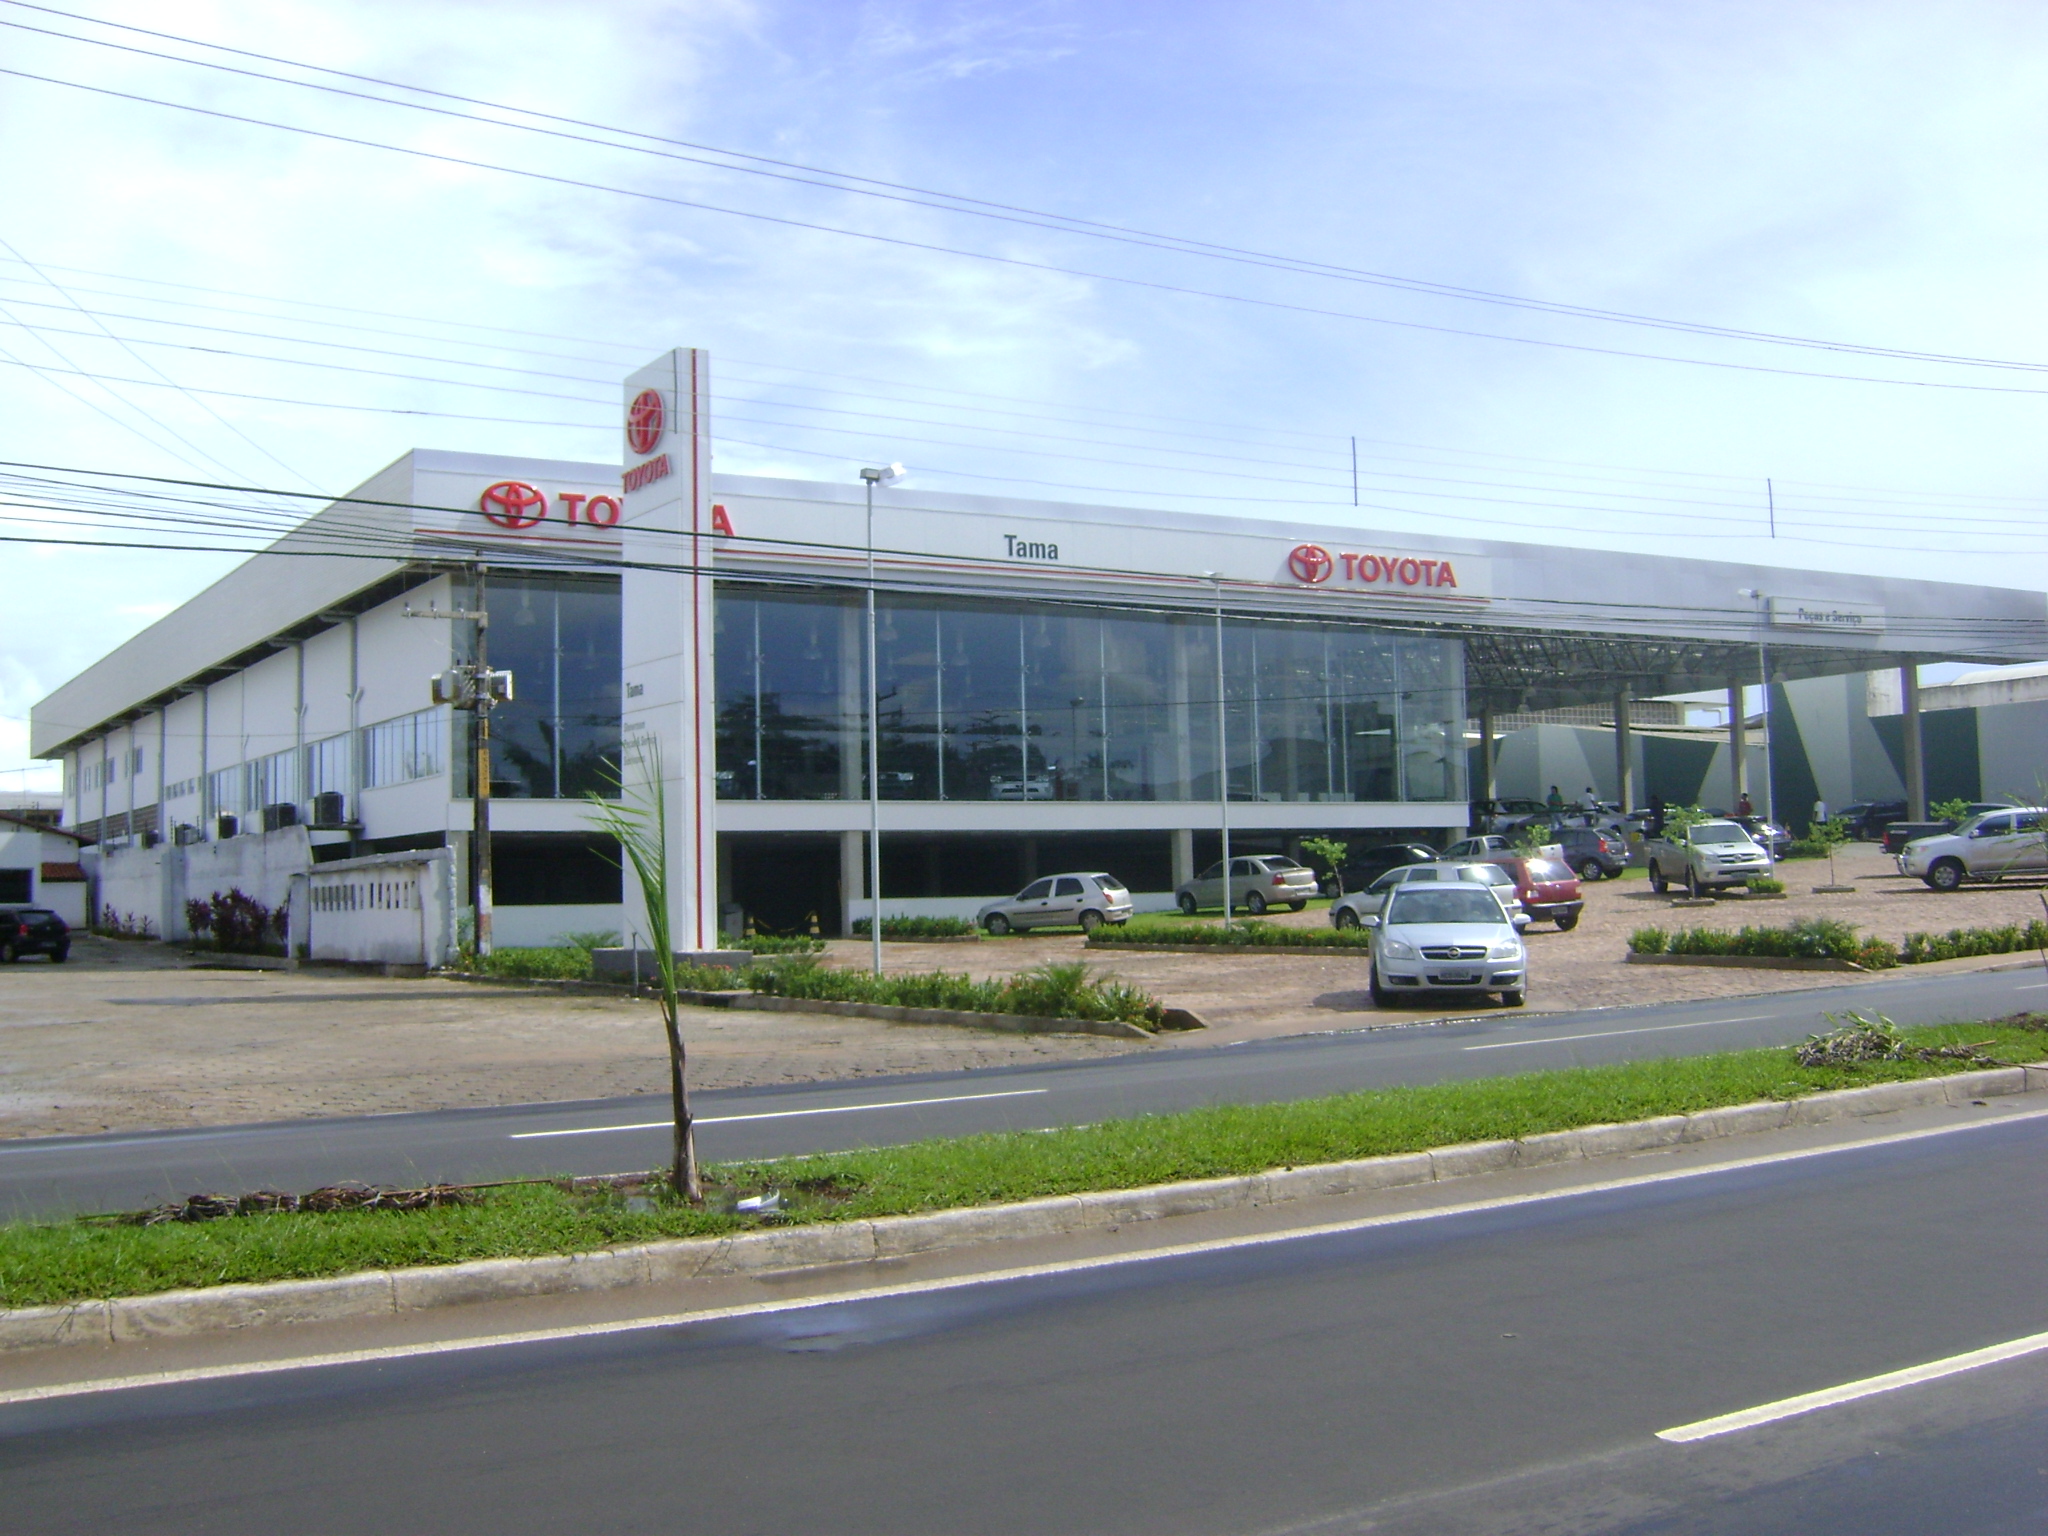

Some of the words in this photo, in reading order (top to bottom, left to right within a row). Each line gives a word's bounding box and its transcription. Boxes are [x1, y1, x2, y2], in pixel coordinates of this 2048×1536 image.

[621, 453, 671, 494] TOYOTA
[559, 493, 735, 537] TOA
[1004, 534, 1058, 560] Tama
[1339, 552, 1458, 588] TOYOTA
